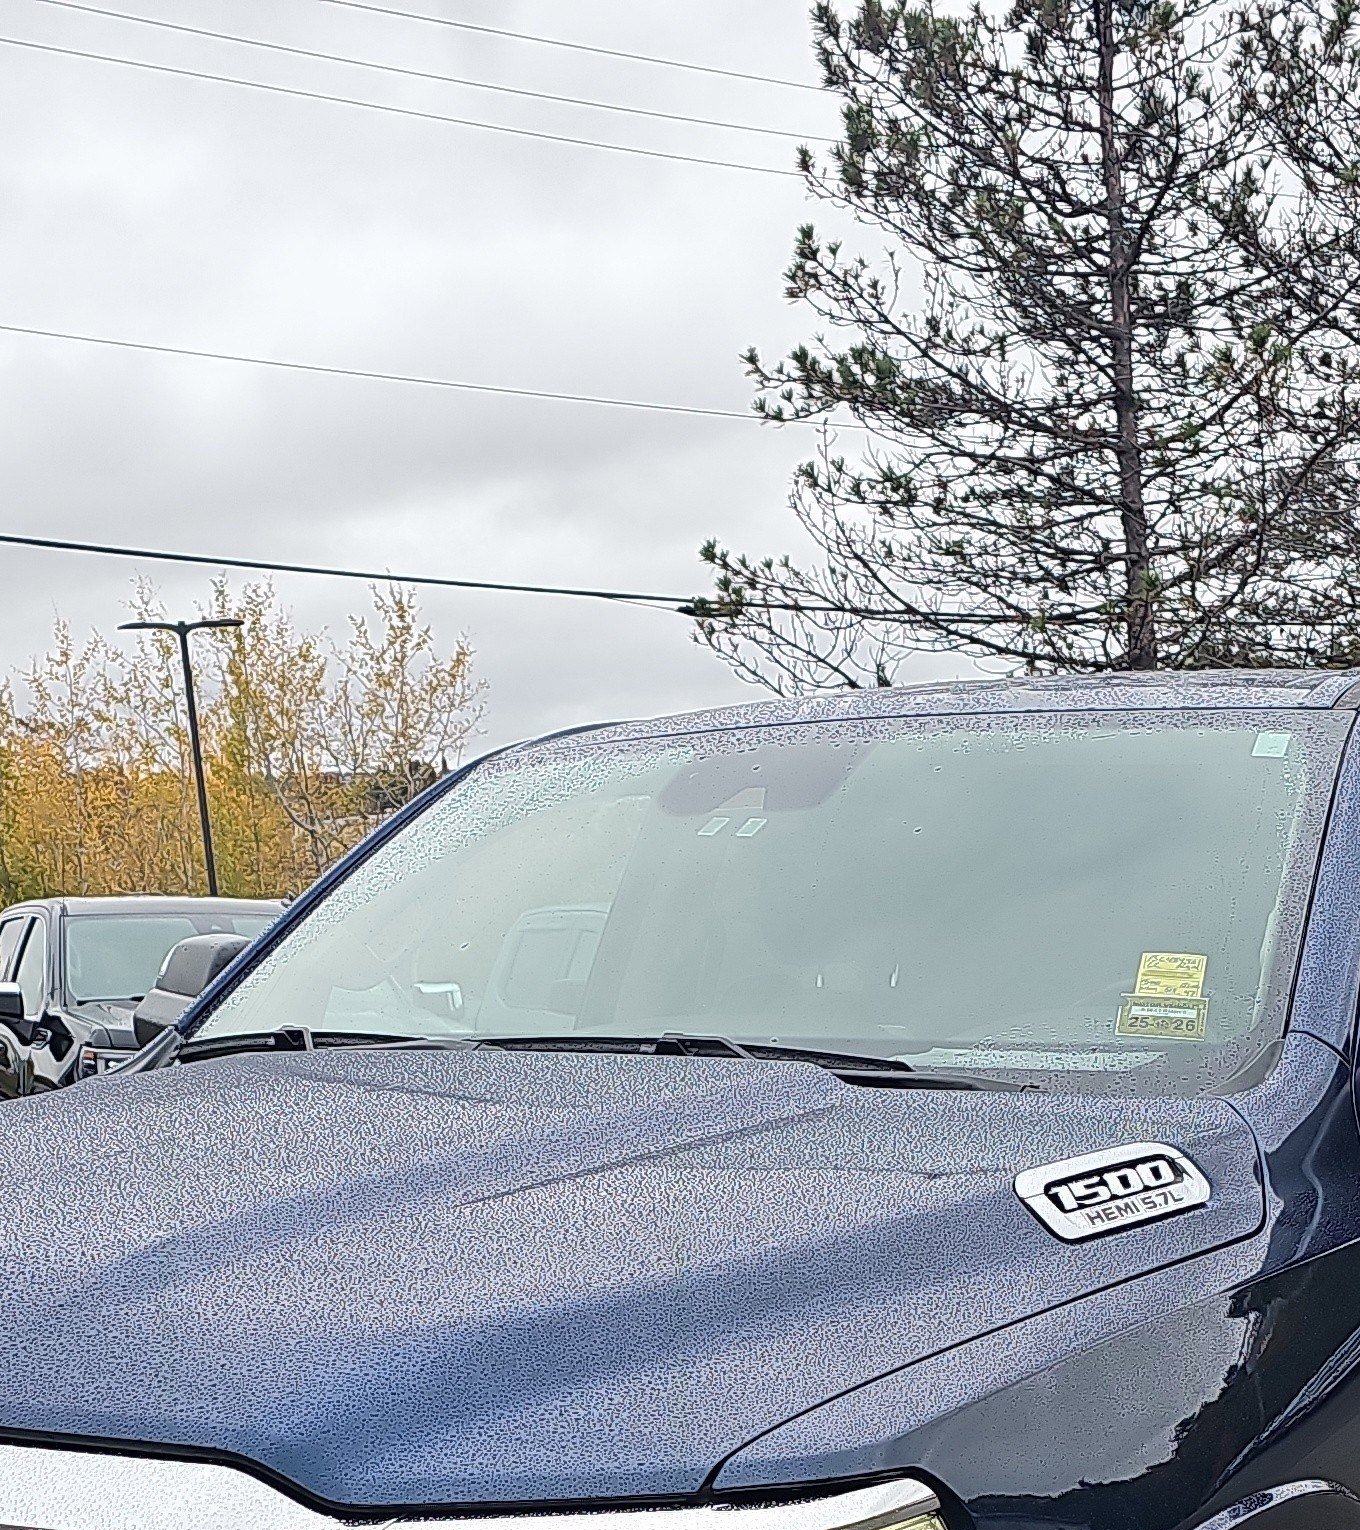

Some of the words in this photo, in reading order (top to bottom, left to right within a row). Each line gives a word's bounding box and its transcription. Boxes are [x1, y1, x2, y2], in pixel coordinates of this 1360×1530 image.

[1172, 1018, 1196, 1032] 26
[1048, 1159, 1175, 1211] 1500
[1084, 1199, 1140, 1226] HEMI
[1142, 1189, 1185, 1210] 5.7L
